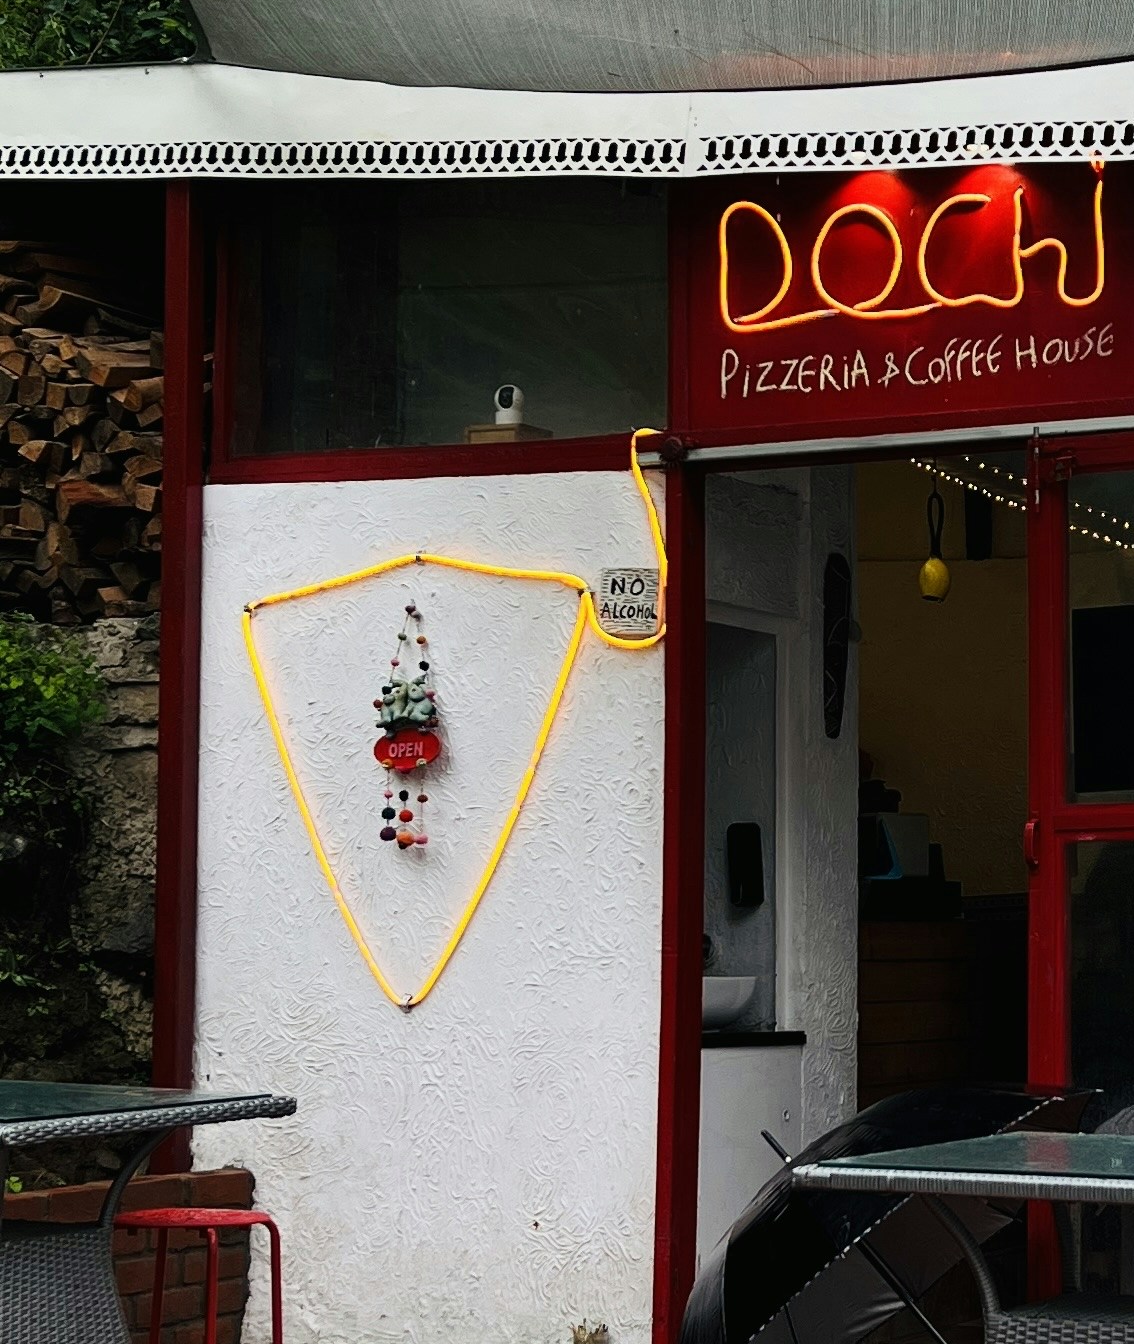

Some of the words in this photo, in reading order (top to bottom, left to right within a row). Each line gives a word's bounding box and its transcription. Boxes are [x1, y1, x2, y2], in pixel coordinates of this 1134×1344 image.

[1015, 323, 1114, 371] HOUSE
[611, 577, 645, 596] NO
[600, 602, 658, 619] ALCOHOL
[389, 741, 423, 758] OPEN
